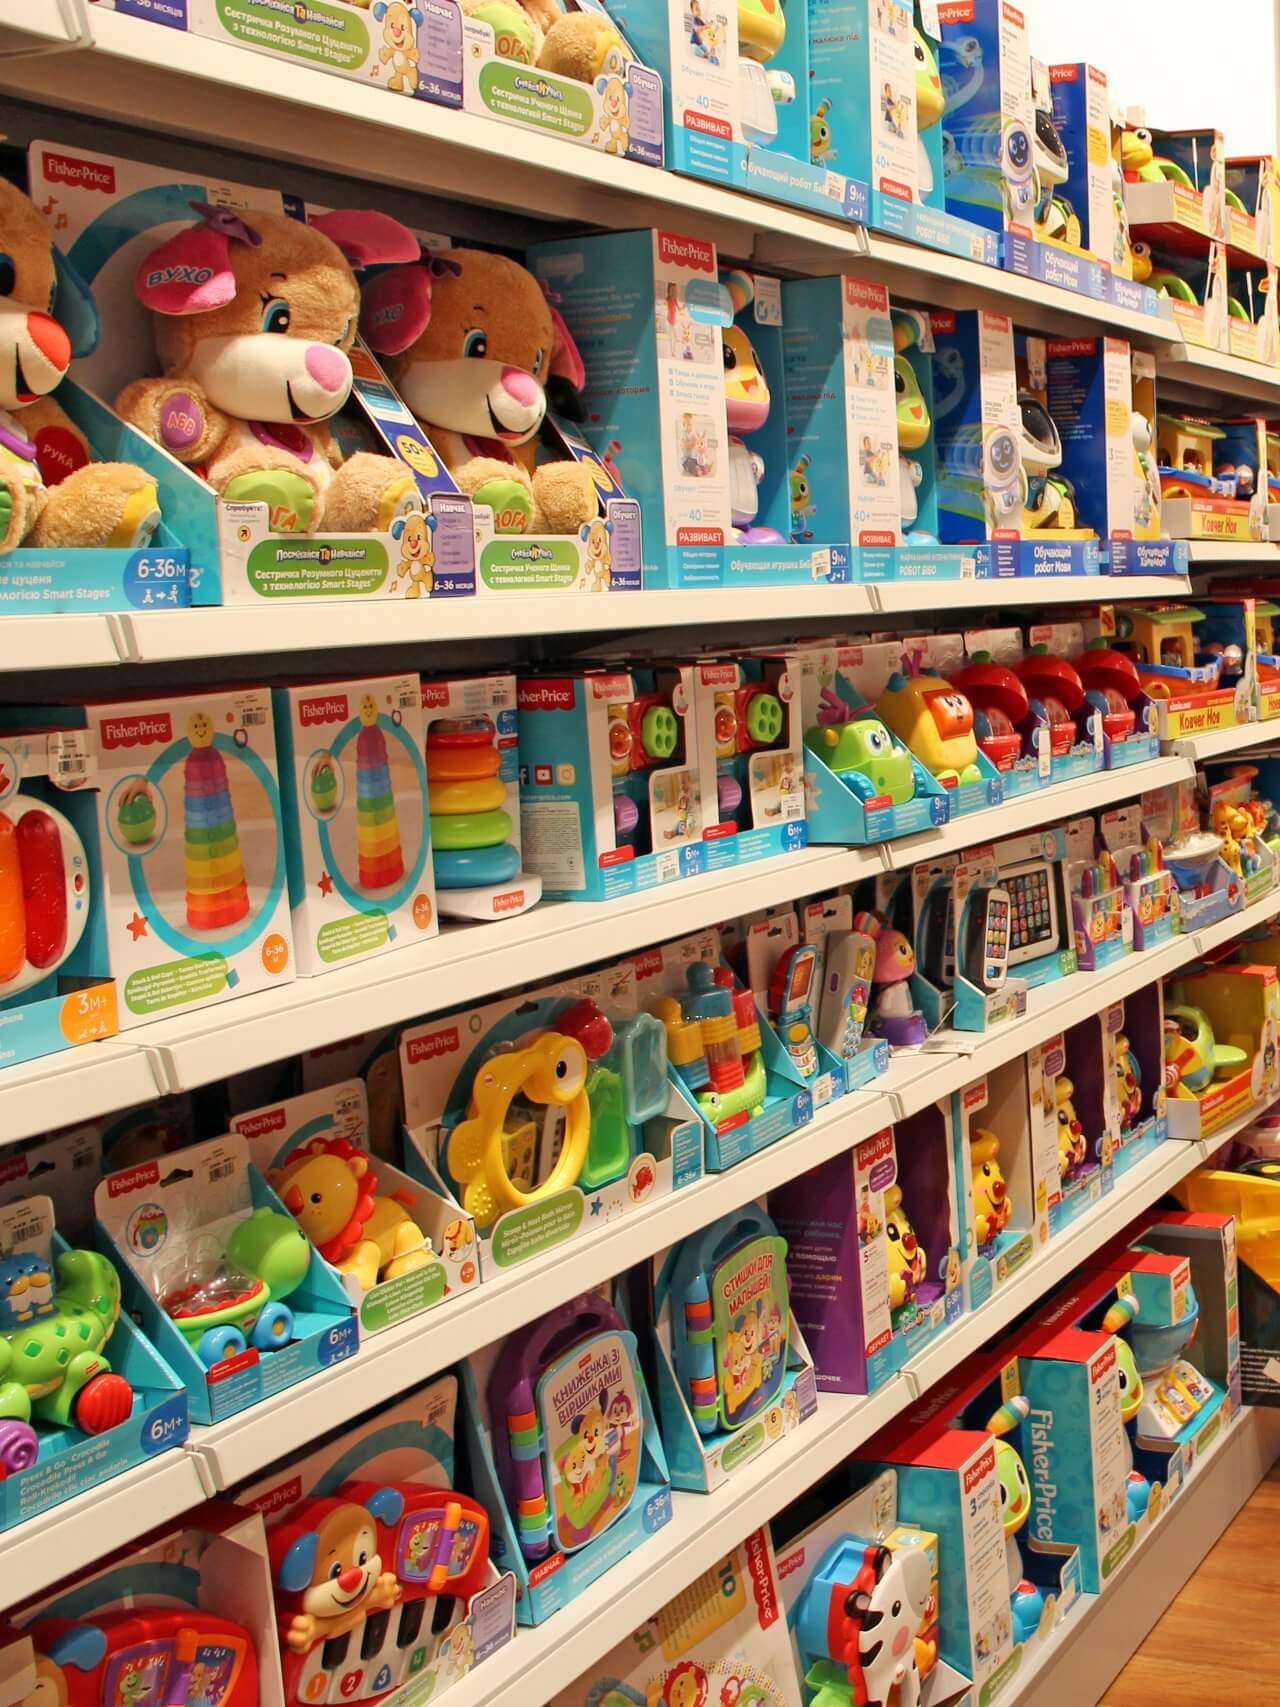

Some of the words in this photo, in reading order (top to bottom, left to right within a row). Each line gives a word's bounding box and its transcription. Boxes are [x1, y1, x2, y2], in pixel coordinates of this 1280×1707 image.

[938, 5, 971, 22] er-Price
[297, 39, 322, 55] Smart
[324, 44, 353, 64] Stages
[685, 114, 732, 138] РАЗВИВАЕТ
[48, 158, 111, 185] Fisher-Price
[662, 238, 710, 263] Fisher-Price
[146, 266, 213, 288] ВУХО
[370, 303, 405, 324] УХО
[679, 532, 721, 544] РАЗВИВАЕТ
[43, 588, 73, 600] Smart
[76, 586, 111, 600] Stages
[322, 580, 346, 591] Smart
[347, 578, 371, 591] Stages
[422, 690, 446, 702] r-Price
[519, 690, 570, 705] sher-Price
[303, 703, 345, 718] Fisher-Price
[107, 722, 167, 740] Fisher-Price
[1179, 711, 1204, 733] Ковчег
[1206, 709, 1220, 726] Ноя
[636, 958, 660, 973] er-Price
[411, 1036, 456, 1056] Fisher-Price
[240, 1115, 284, 1134] Fisher-Price
[111, 1169, 156, 1191] Fisher-Price
[724, 1262, 757, 1298] СТИШКИ
[757, 1253, 773, 1273] ДЛЯ
[552, 1356, 610, 1407] КНИЖЕЧКА
[557, 1367, 623, 1425] ВІРШИКАМИ
[771, 1412, 777, 1424] 6
[151, 1418, 183, 1441] 6M+
[1031, 1408, 1057, 1540] Fisher-Price
[254, 1486, 297, 1512] er-Price
[970, 1497, 977, 1517] 3
[313, 1678, 320, 1693] 1
[347, 1675, 355, 1692] 2
[378, 1669, 387, 1685] 3
